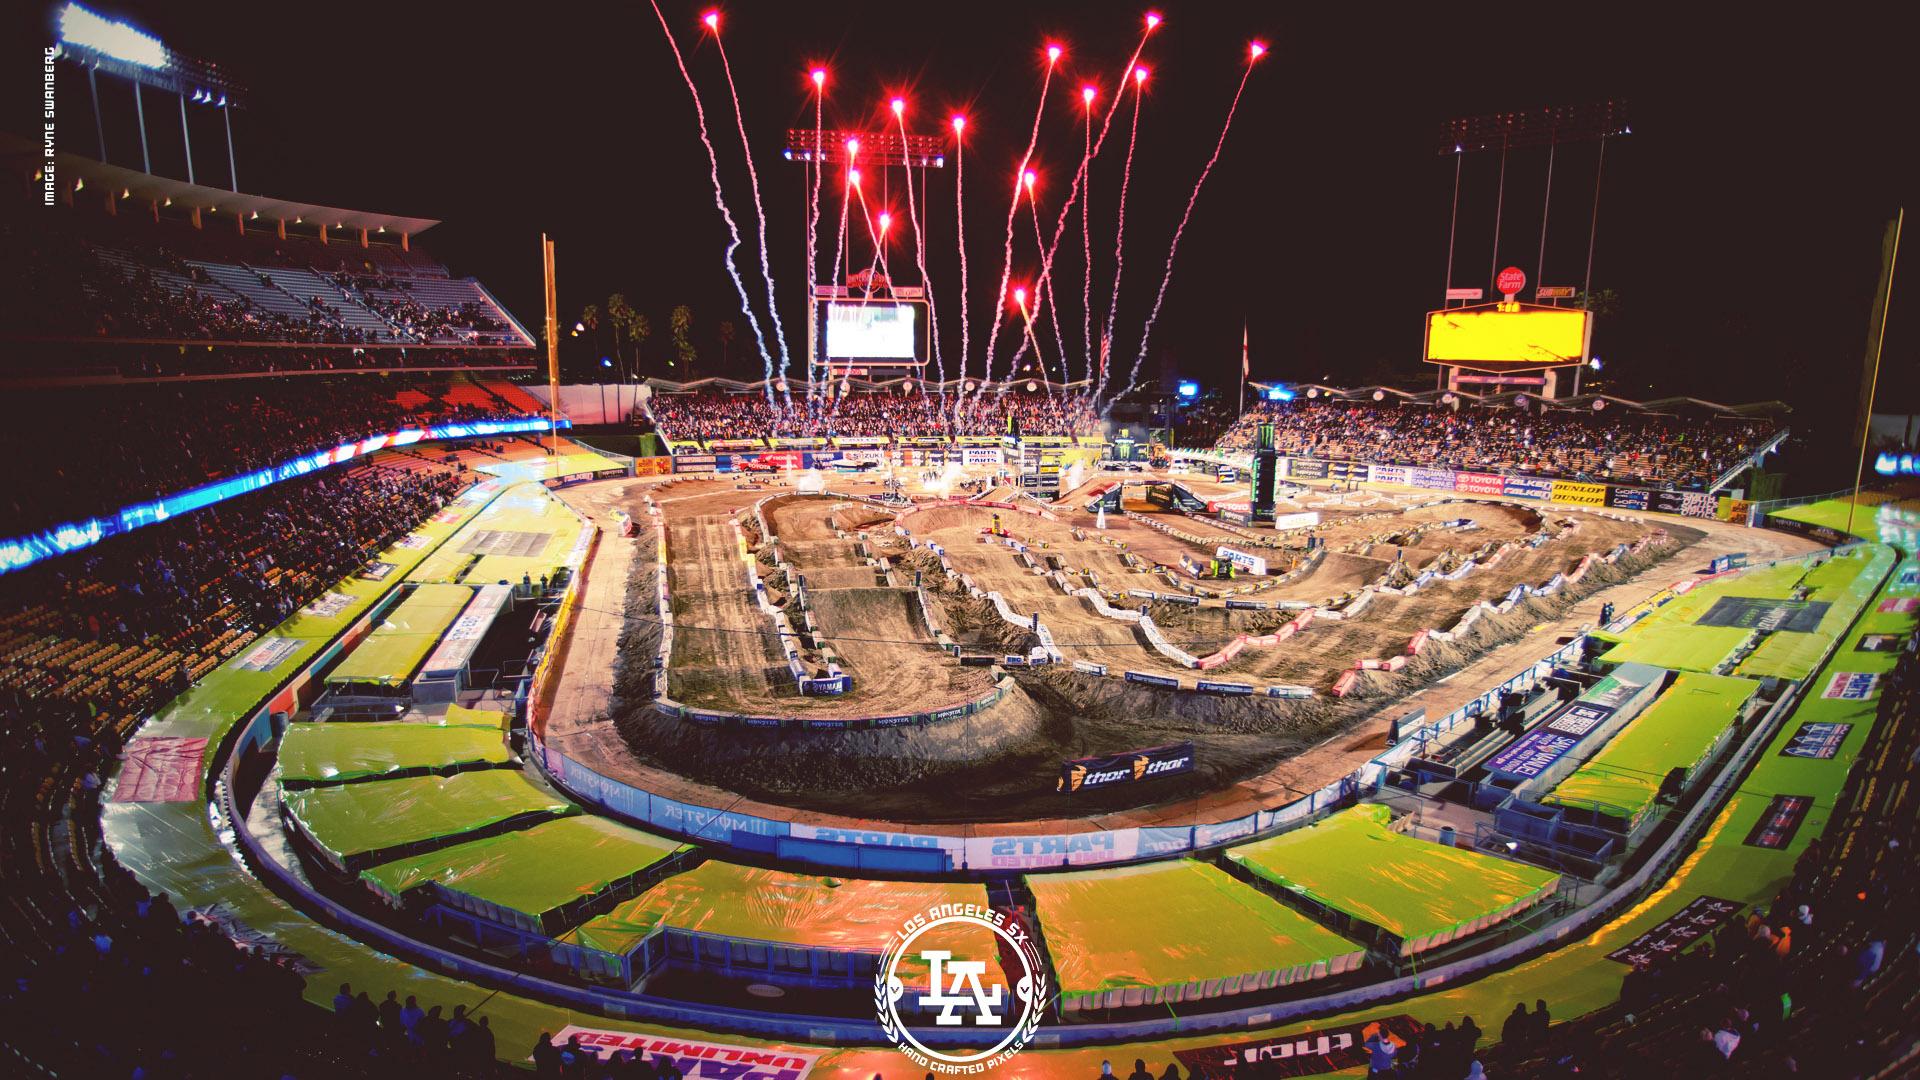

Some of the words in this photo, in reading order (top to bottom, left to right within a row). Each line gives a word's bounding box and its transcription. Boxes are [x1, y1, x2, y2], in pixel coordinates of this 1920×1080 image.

[1500, 271, 1521, 281] State
[1499, 280, 1521, 289] Farm
[1538, 288, 1571, 297] SUBWAY
[1470, 475, 1502, 485] TOYOTA
[1504, 478, 1552, 490] FALKEN
[1469, 485, 1502, 495] TOYOTA
[1503, 487, 1551, 499] FALKEN
[1554, 484, 1605, 493] DUNLOP
[1615, 488, 1649, 496] GoPro
[1553, 494, 1603, 504] DUNLOP
[1613, 498, 1648, 506] GoPro
[1681, 510, 1715, 519] OPTICS
[878, 717, 910, 725] MONSTER
[1084, 769, 1131, 785] thor
[1146, 757, 1189, 774] thor
[570, 1030, 807, 1070] UNLIMITED
